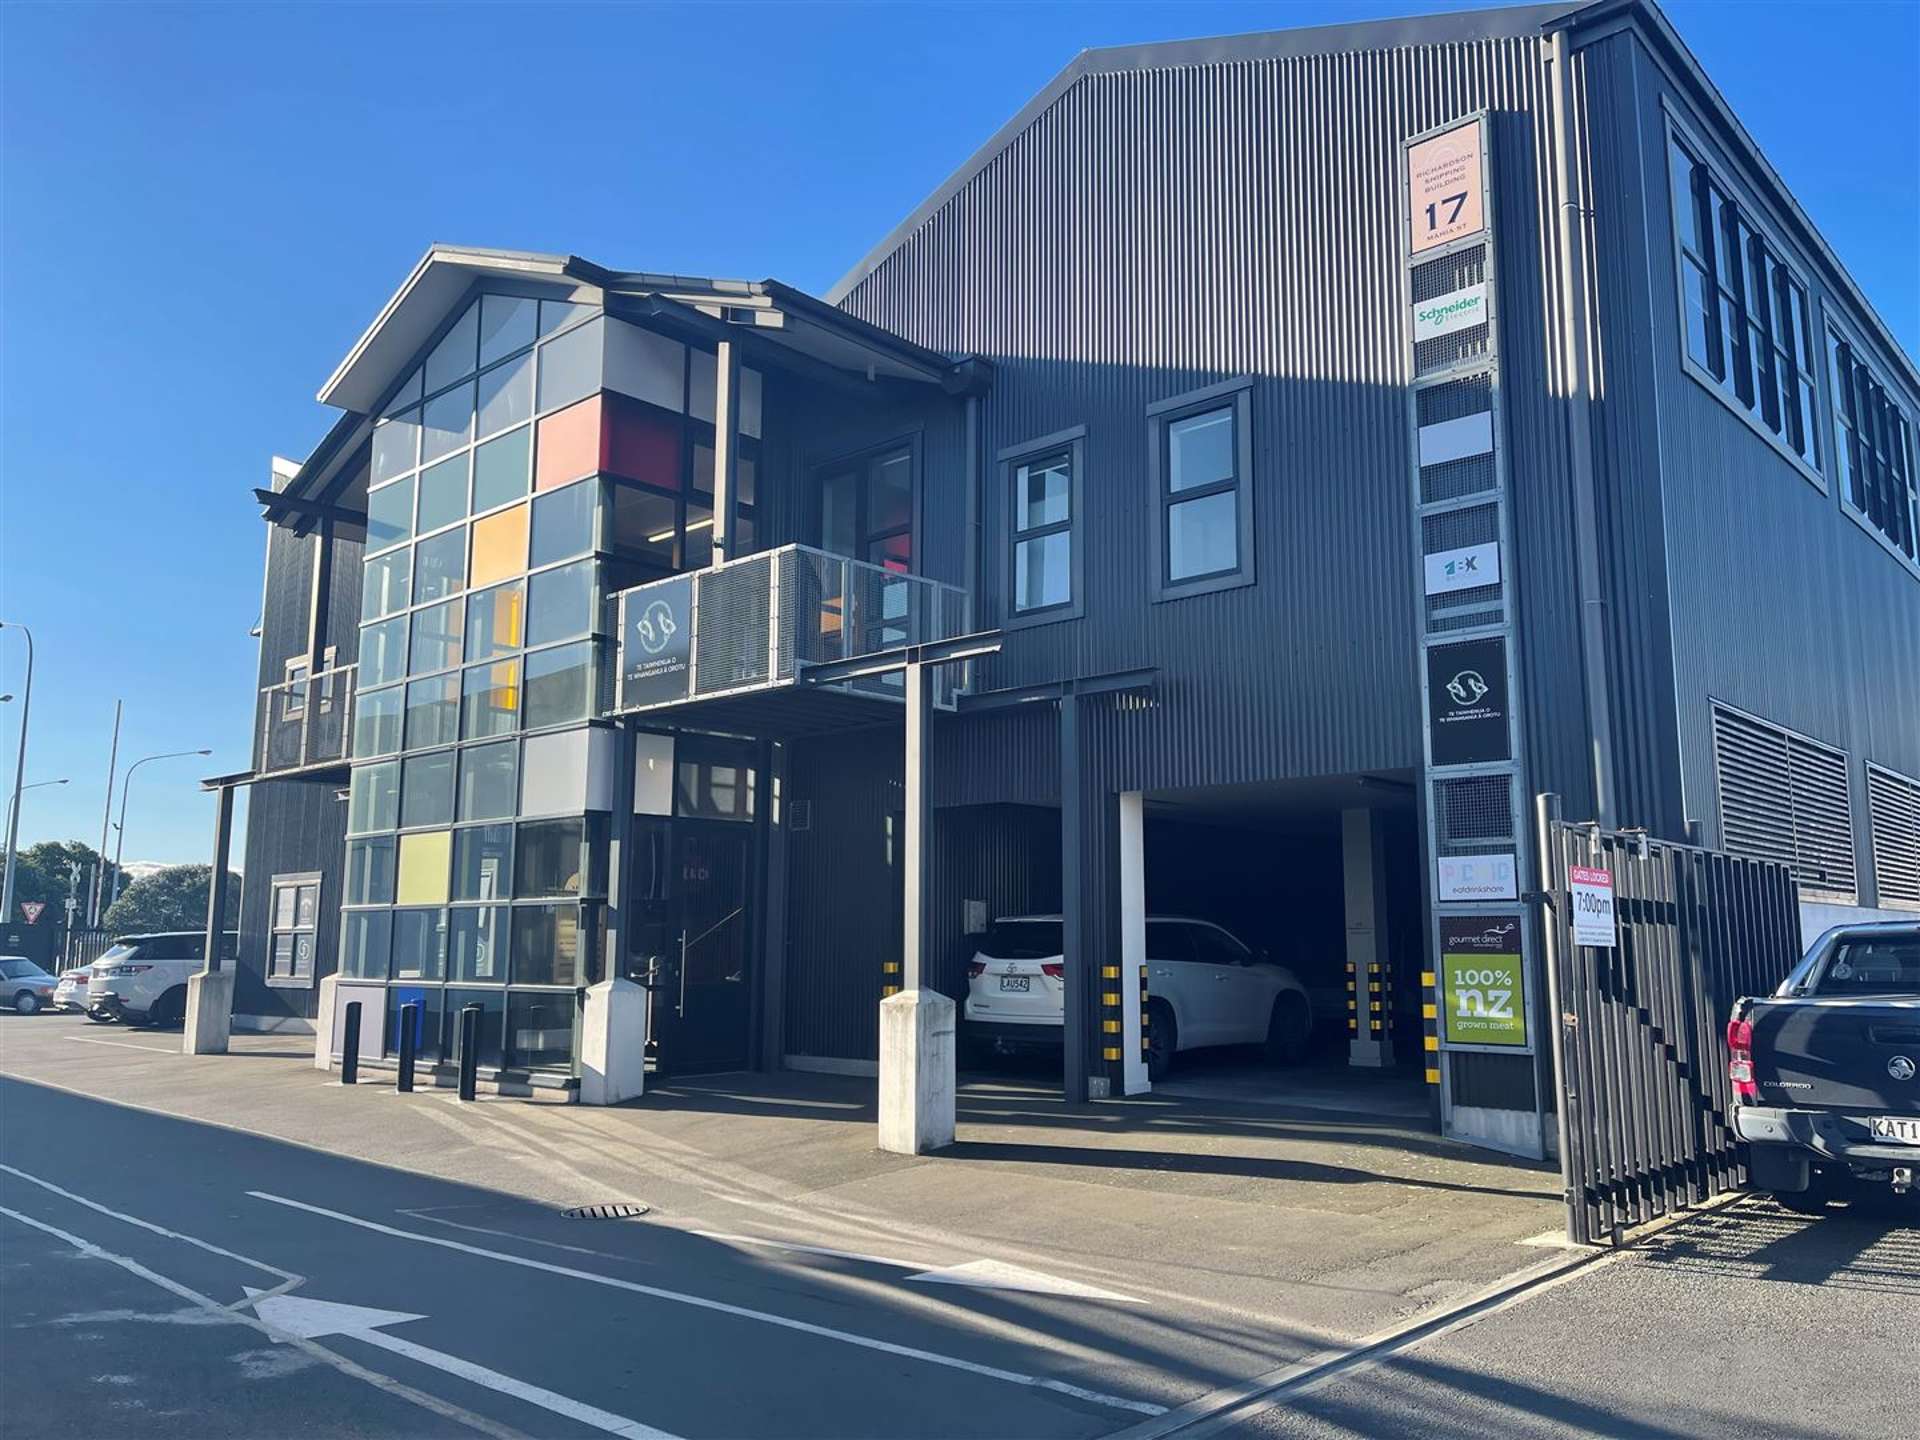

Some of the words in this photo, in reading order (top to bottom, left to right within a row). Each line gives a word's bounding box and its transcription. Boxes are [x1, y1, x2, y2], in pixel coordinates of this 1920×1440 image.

[1416, 153, 1473, 179] RICHARDSON
[1424, 165, 1466, 184] SHIPPING
[1424, 174, 1466, 193] BUILDING
[1426, 190, 1468, 231] 17
[1427, 228, 1455, 241] MAHIA
[1419, 296, 1481, 323] Schneider
[1577, 891, 1612, 919] 7:00pm
[1449, 936, 1480, 946] gourmet
[1481, 933, 1503, 944] direct
[1454, 969, 1512, 986] 100%
[1455, 988, 1514, 1019] nz
[1456, 1021, 1488, 1031] grown
[1489, 1021, 1515, 1031] meat
[1763, 1080, 1812, 1090] COLORADO
